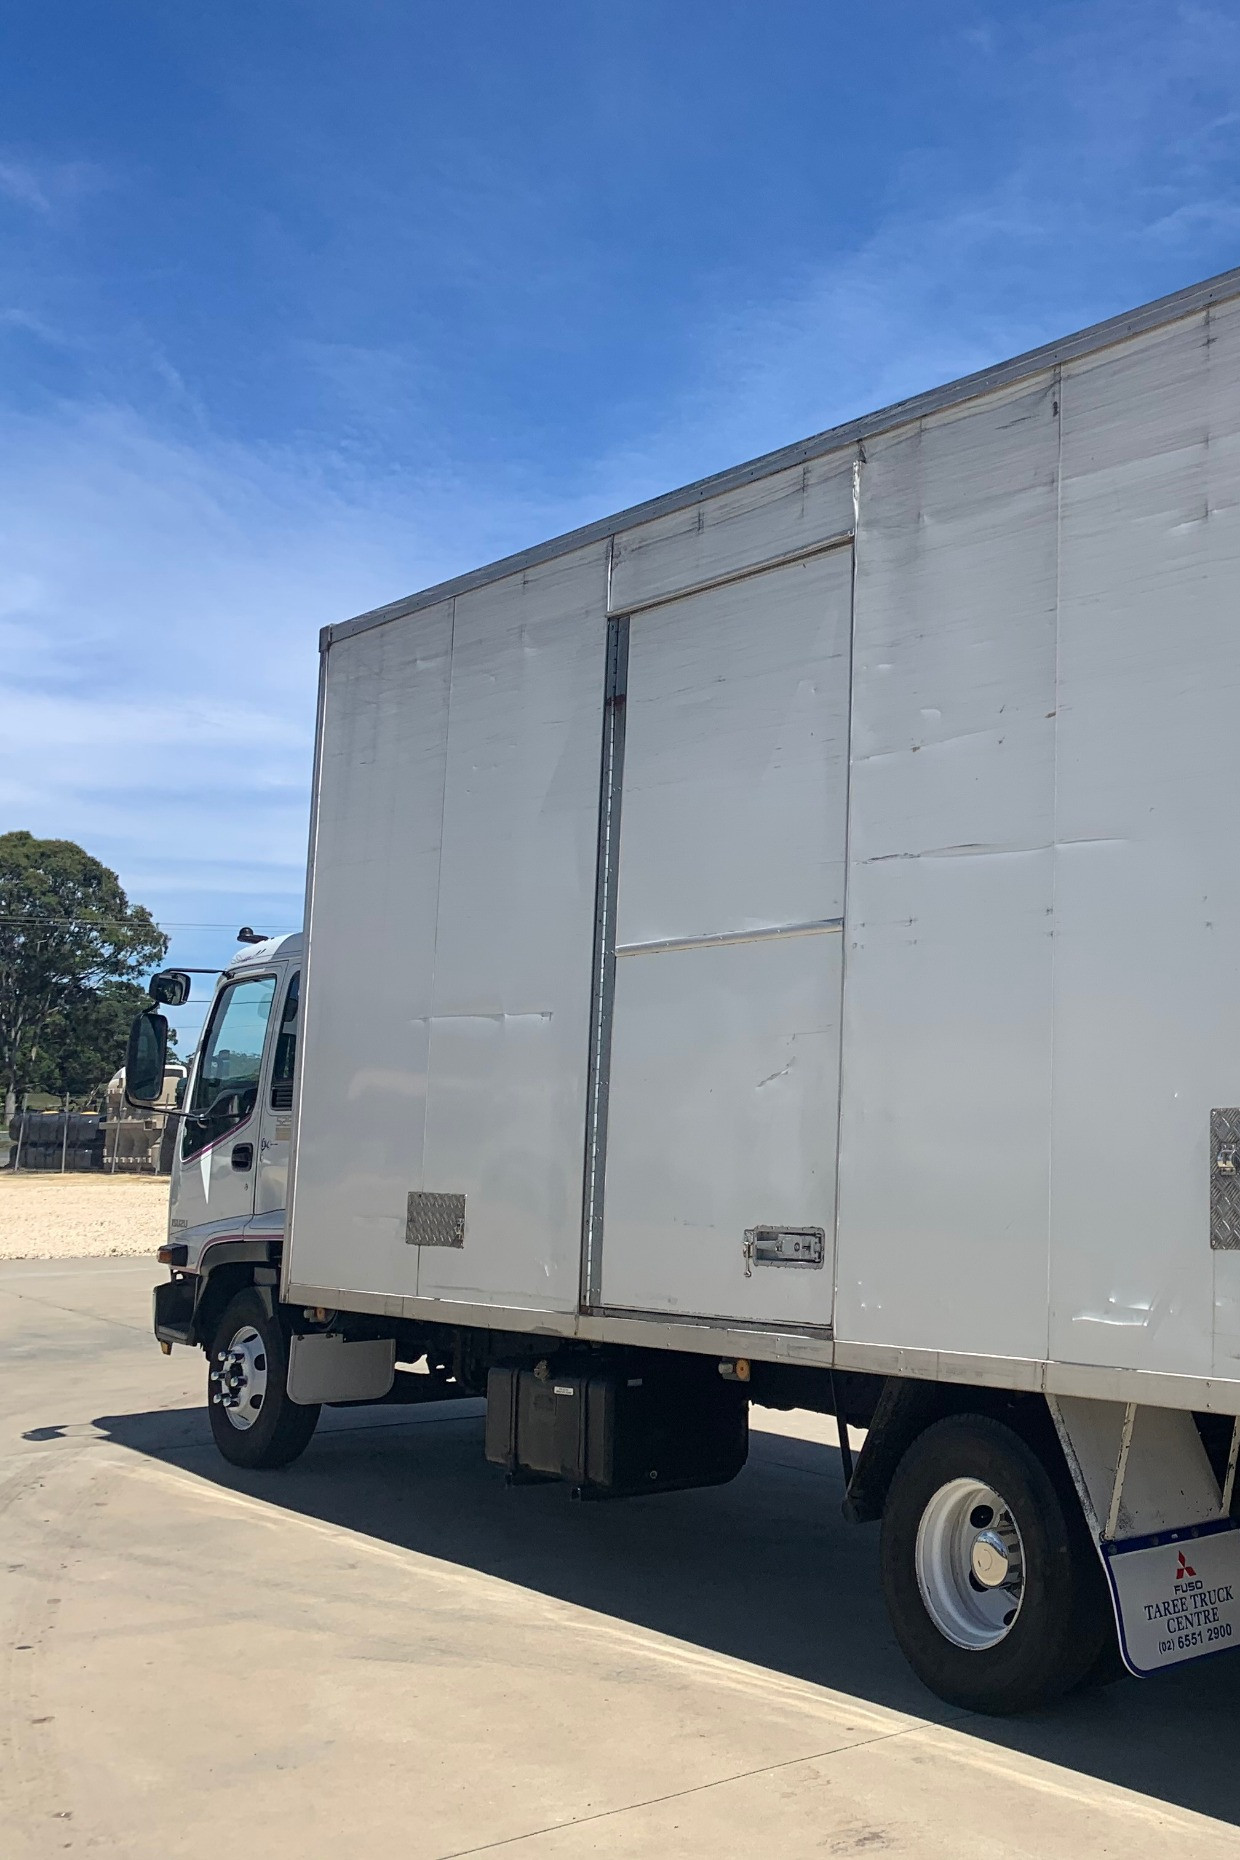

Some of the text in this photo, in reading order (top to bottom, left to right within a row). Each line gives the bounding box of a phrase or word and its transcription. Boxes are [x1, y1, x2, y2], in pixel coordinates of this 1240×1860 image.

[1144, 1584, 1235, 1621] TAREE TRUCK
[1173, 1580, 1204, 1596] FUSO
[1166, 1606, 1220, 1635] CENTRE
[1158, 1623, 1233, 1655] (02) 6551 2900
